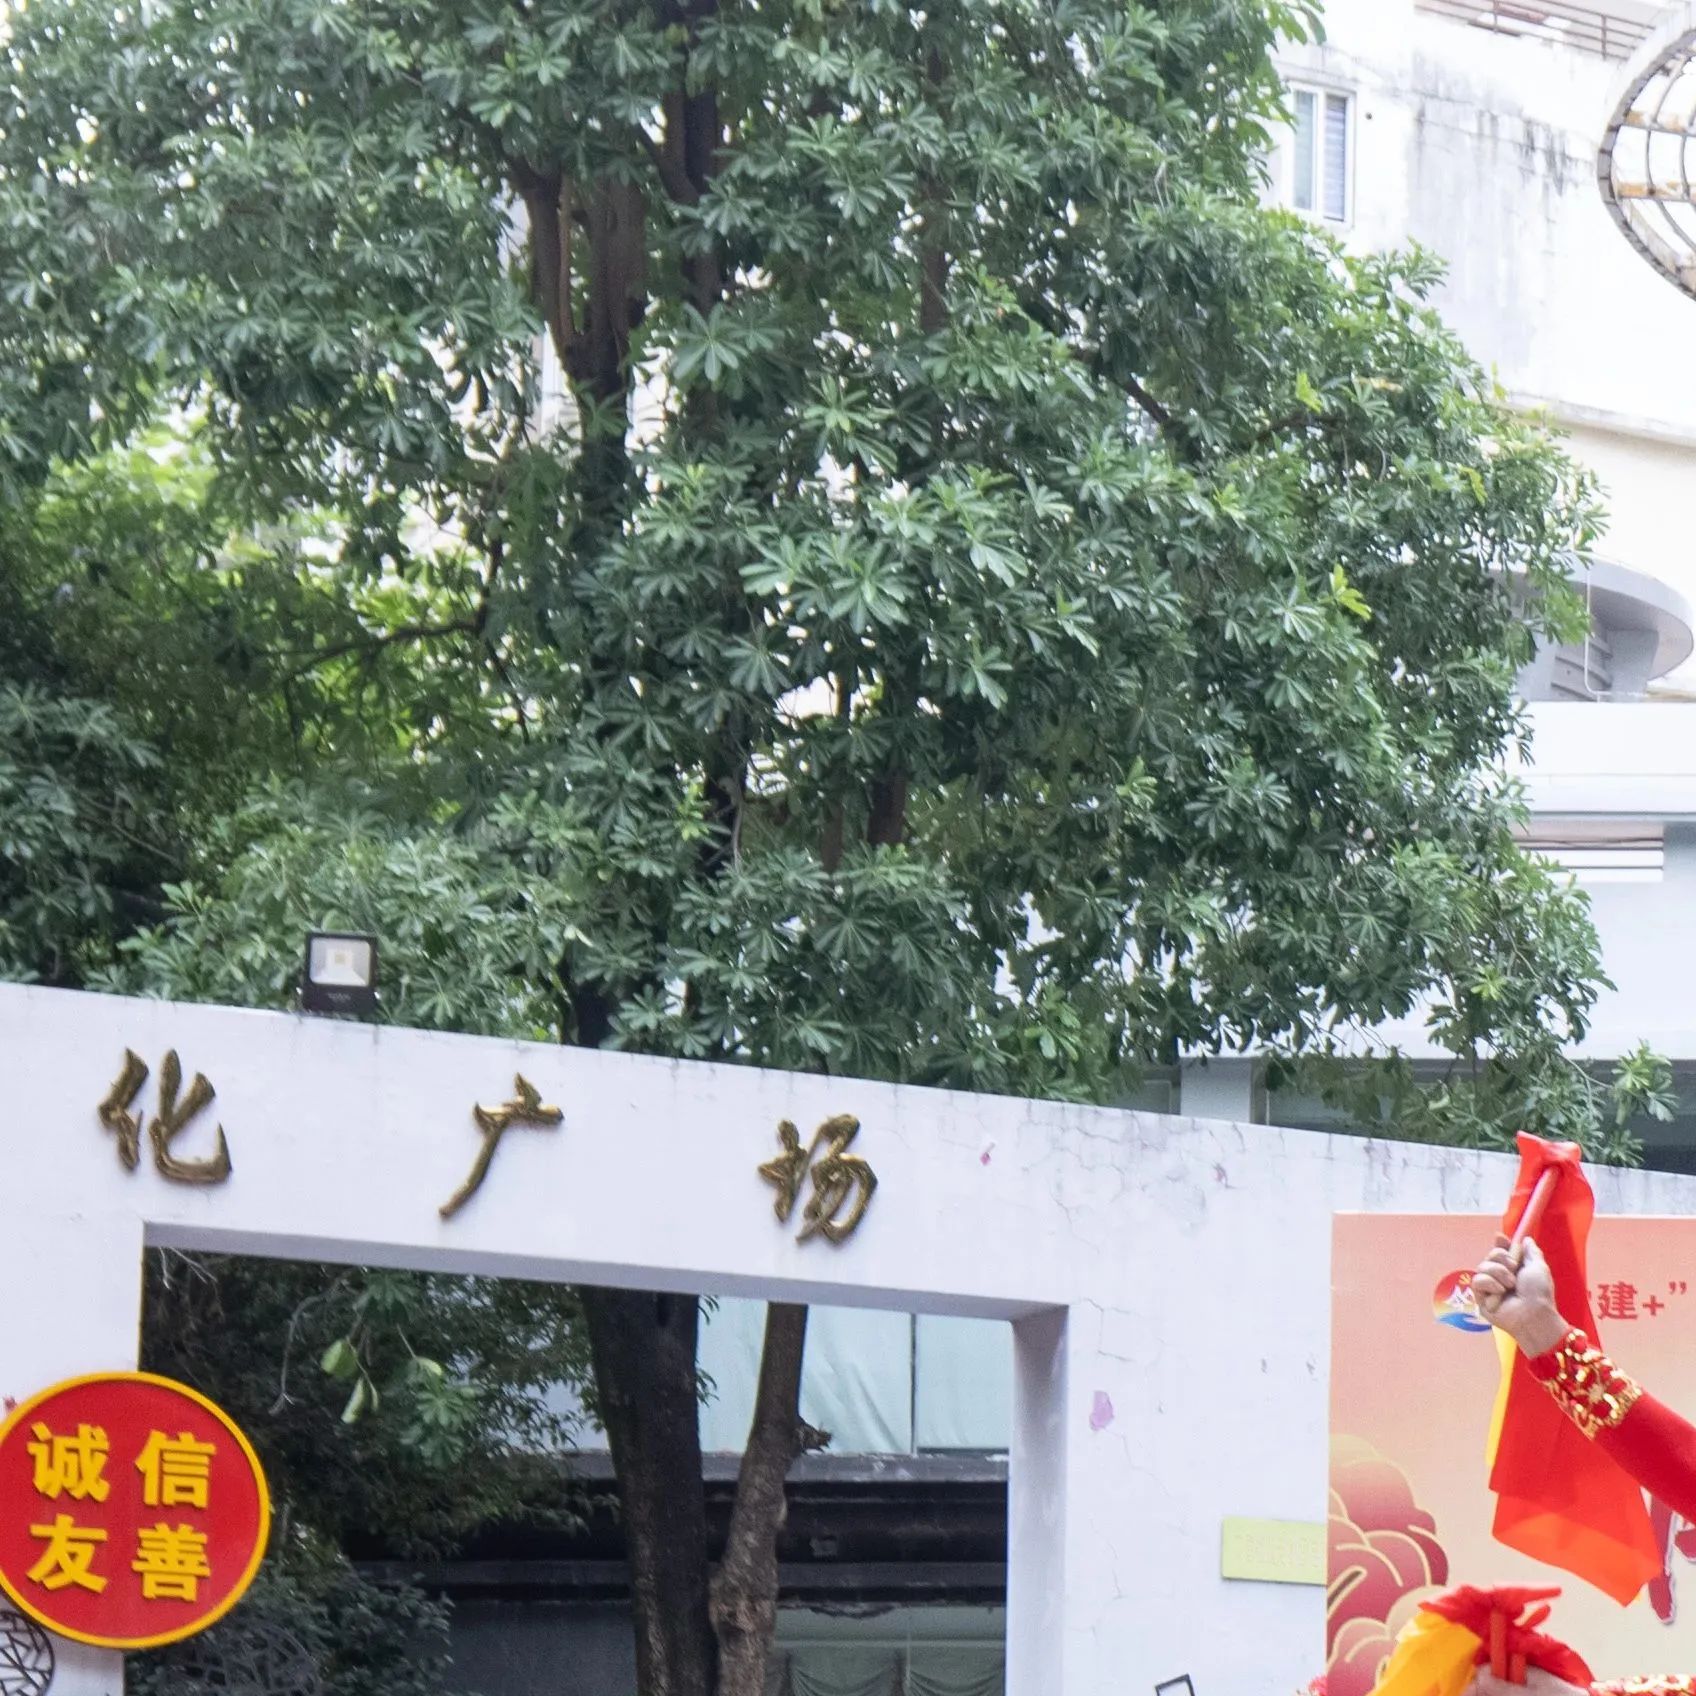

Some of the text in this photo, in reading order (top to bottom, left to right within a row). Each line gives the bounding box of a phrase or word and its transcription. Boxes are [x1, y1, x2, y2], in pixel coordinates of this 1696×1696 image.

[97, 1047, 879, 1249] 化广场
[27, 1422, 216, 1508] 诚信
[27, 1513, 212, 1603] 友善
